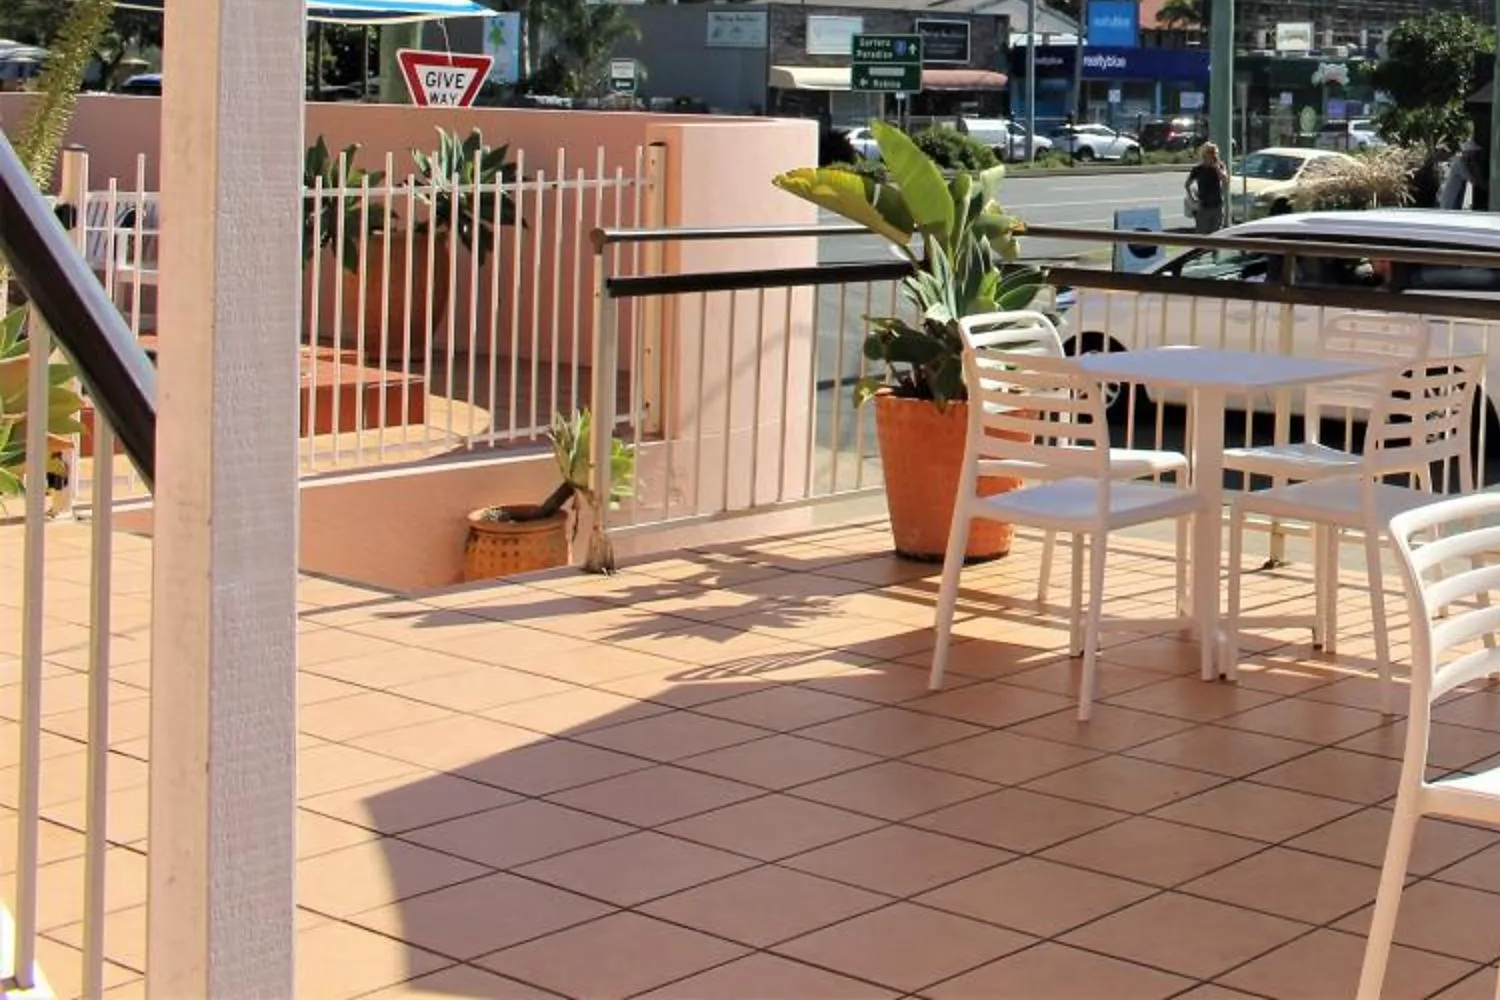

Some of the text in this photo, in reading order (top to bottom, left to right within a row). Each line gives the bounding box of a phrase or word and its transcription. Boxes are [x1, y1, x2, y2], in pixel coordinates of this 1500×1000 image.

[1083, 53, 1127, 71] realtyblue
[425, 71, 465, 89] GIVE
[430, 92, 459, 105] WAY
